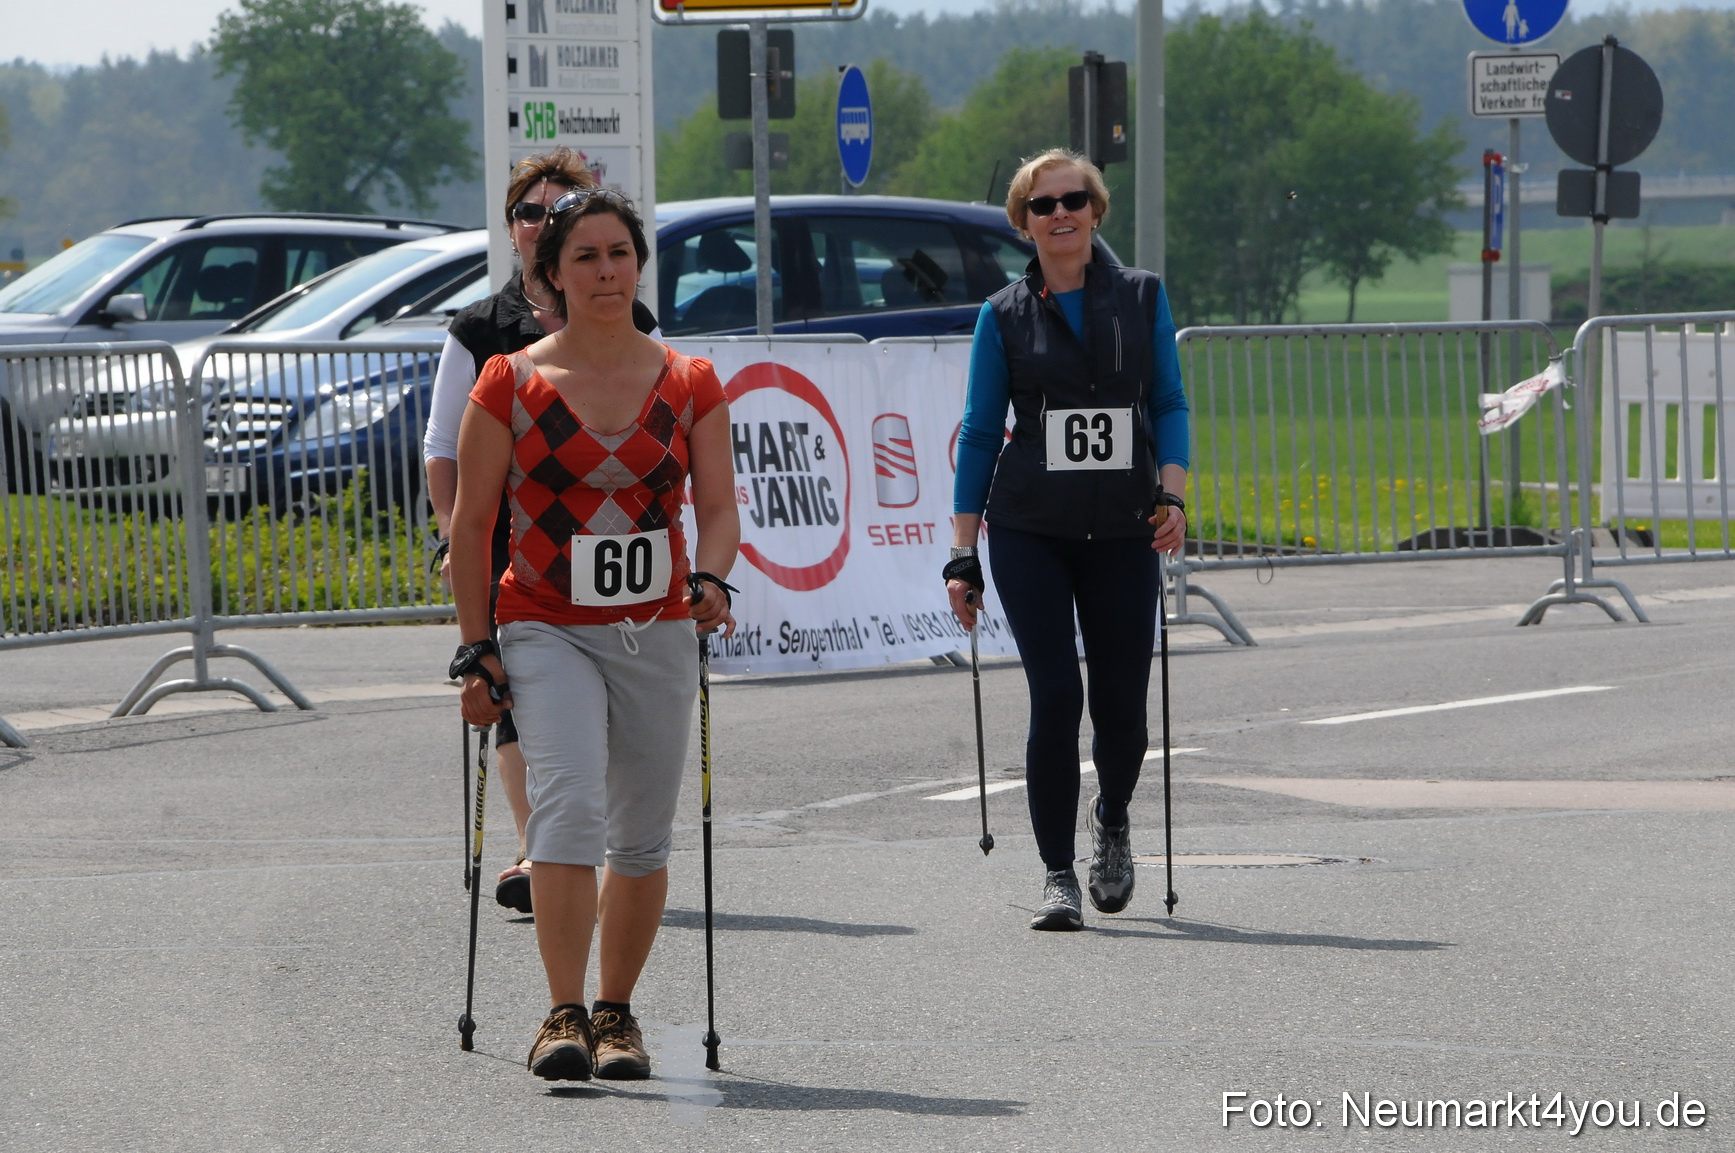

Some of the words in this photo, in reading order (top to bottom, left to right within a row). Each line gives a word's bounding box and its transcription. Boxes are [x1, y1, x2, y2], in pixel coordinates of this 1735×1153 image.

[557, 45, 619, 68] HOLZAMMER
[1486, 60, 1546, 76] Landwirt-
[1480, 77, 1549, 93] schaftliche
[1480, 95, 1526, 110] Verkehr
[1532, 92, 1546, 108] fr
[524, 102, 556, 142] SHB
[559, 107, 620, 134] Holzfachmarkt
[814, 434, 826, 461] &
[1065, 412, 1113, 462] 63
[750, 475, 840, 528] JÄNIG
[868, 522, 936, 546] SEAT
[594, 537, 653, 597] 60
[708, 622, 761, 659] umarkt
[778, 617, 864, 661] Sengenthal
[870, 614, 905, 646] Tel.
